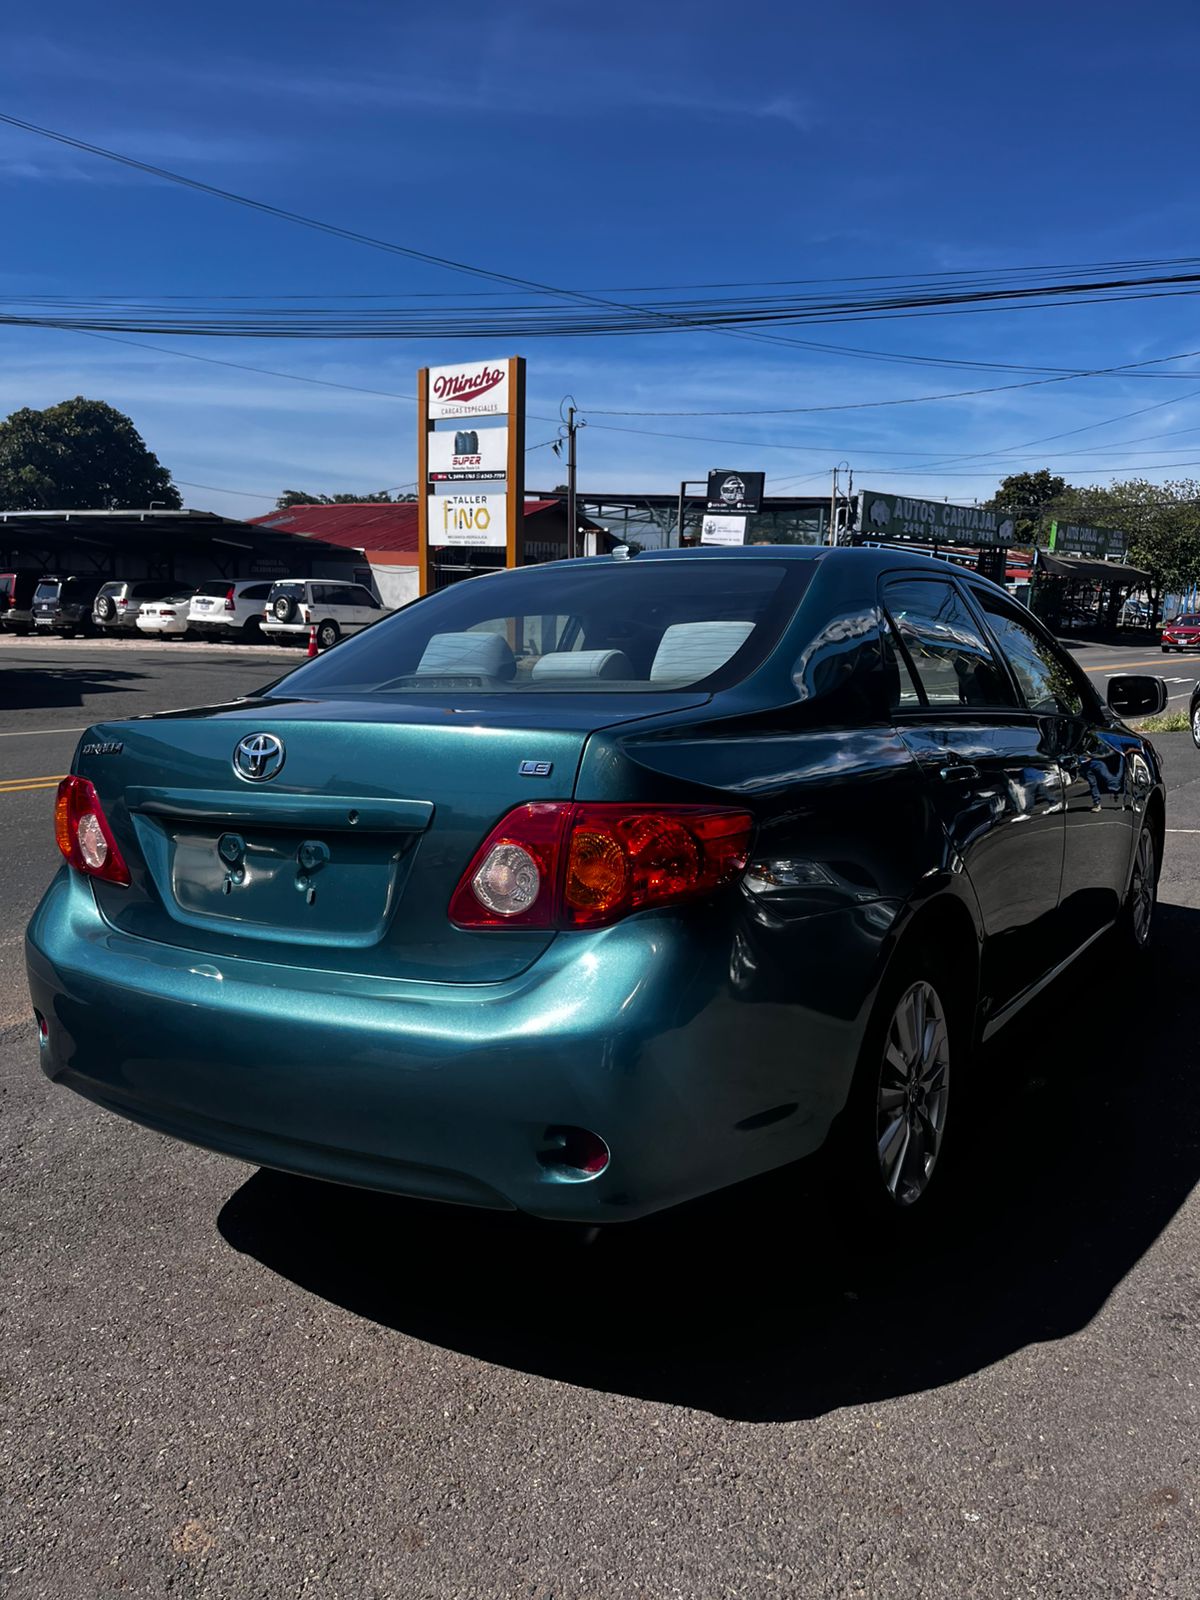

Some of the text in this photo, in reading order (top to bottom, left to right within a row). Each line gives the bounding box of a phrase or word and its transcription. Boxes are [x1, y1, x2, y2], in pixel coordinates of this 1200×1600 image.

[433, 366, 505, 399] Mincho
[441, 404, 498, 415] CARGAS ESPECIALES
[452, 456, 481, 465] SUPER
[453, 496, 487, 504] TALLER
[893, 498, 998, 531] AUTOS CARVAJAL
[519, 760, 552, 775] LE
